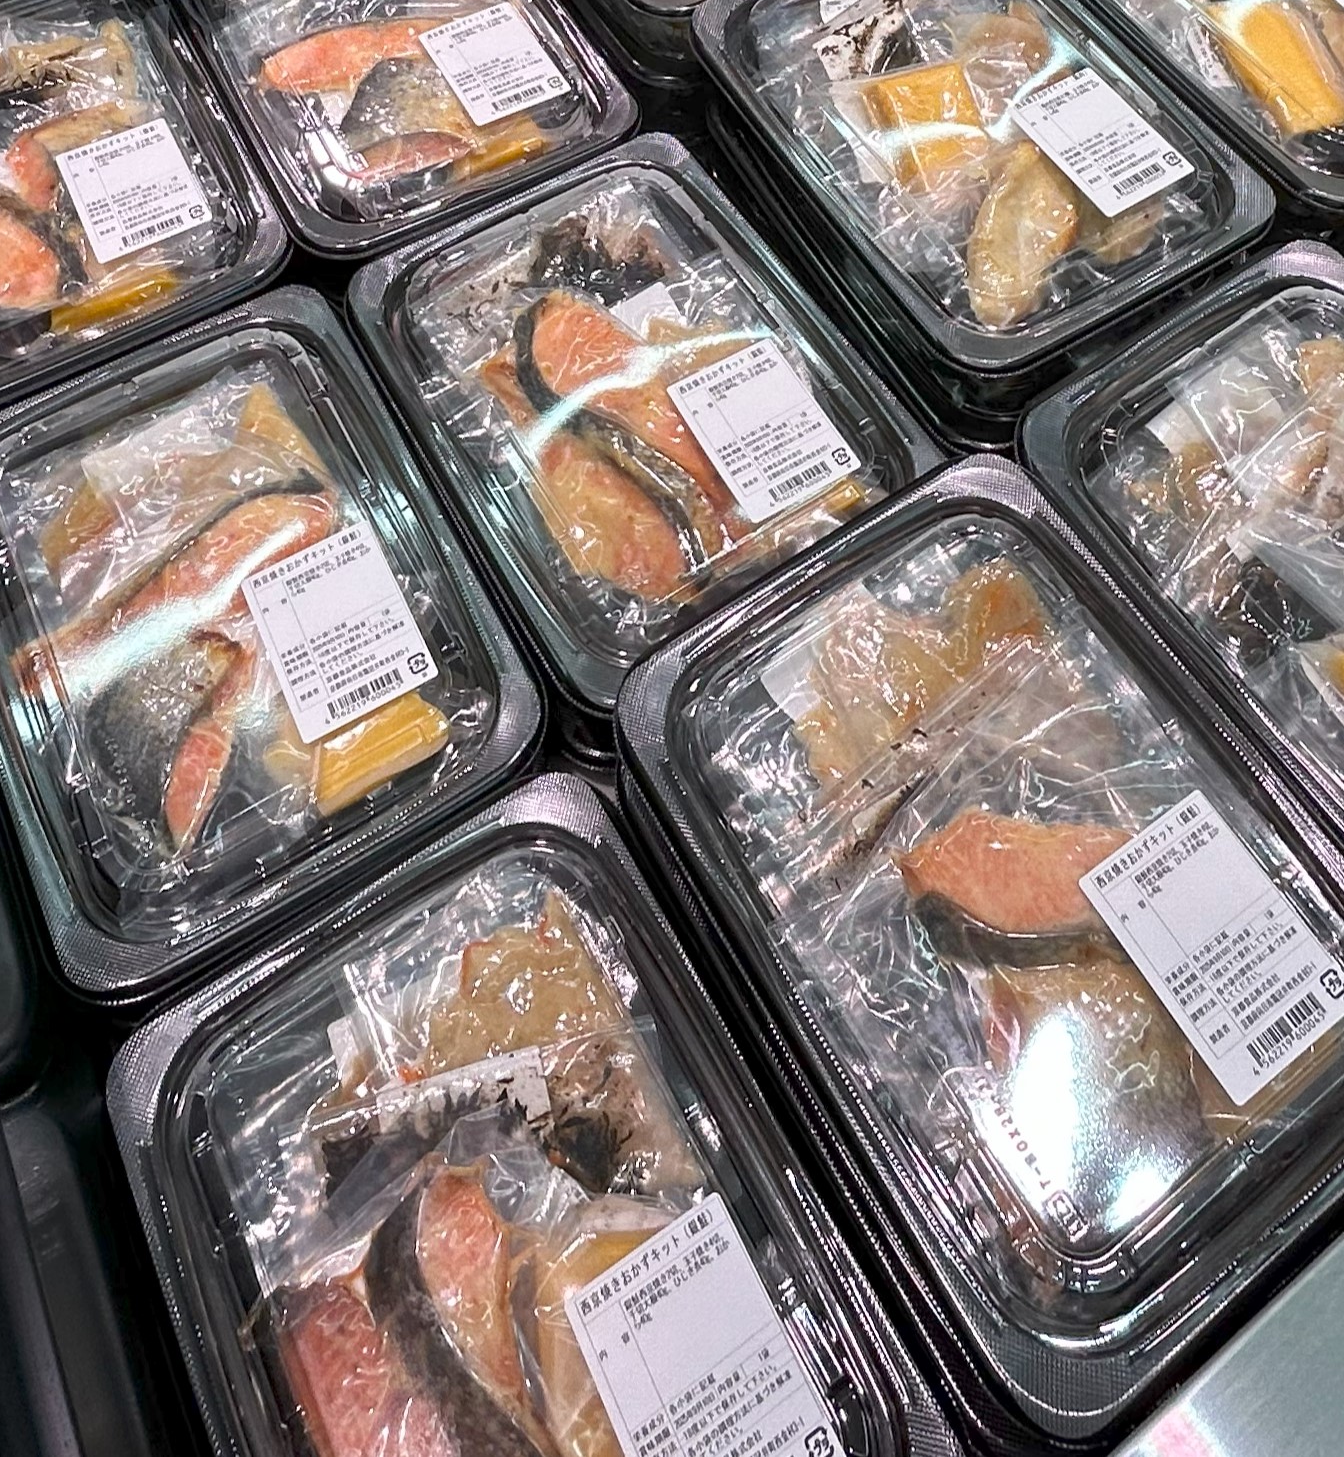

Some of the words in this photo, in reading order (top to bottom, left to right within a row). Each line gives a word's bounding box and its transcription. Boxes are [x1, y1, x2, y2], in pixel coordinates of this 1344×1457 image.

[1261, 1036, 1294, 1069] 562219
[578, 1207, 715, 1316] 西京焼きおかずキット(銀鮭)
